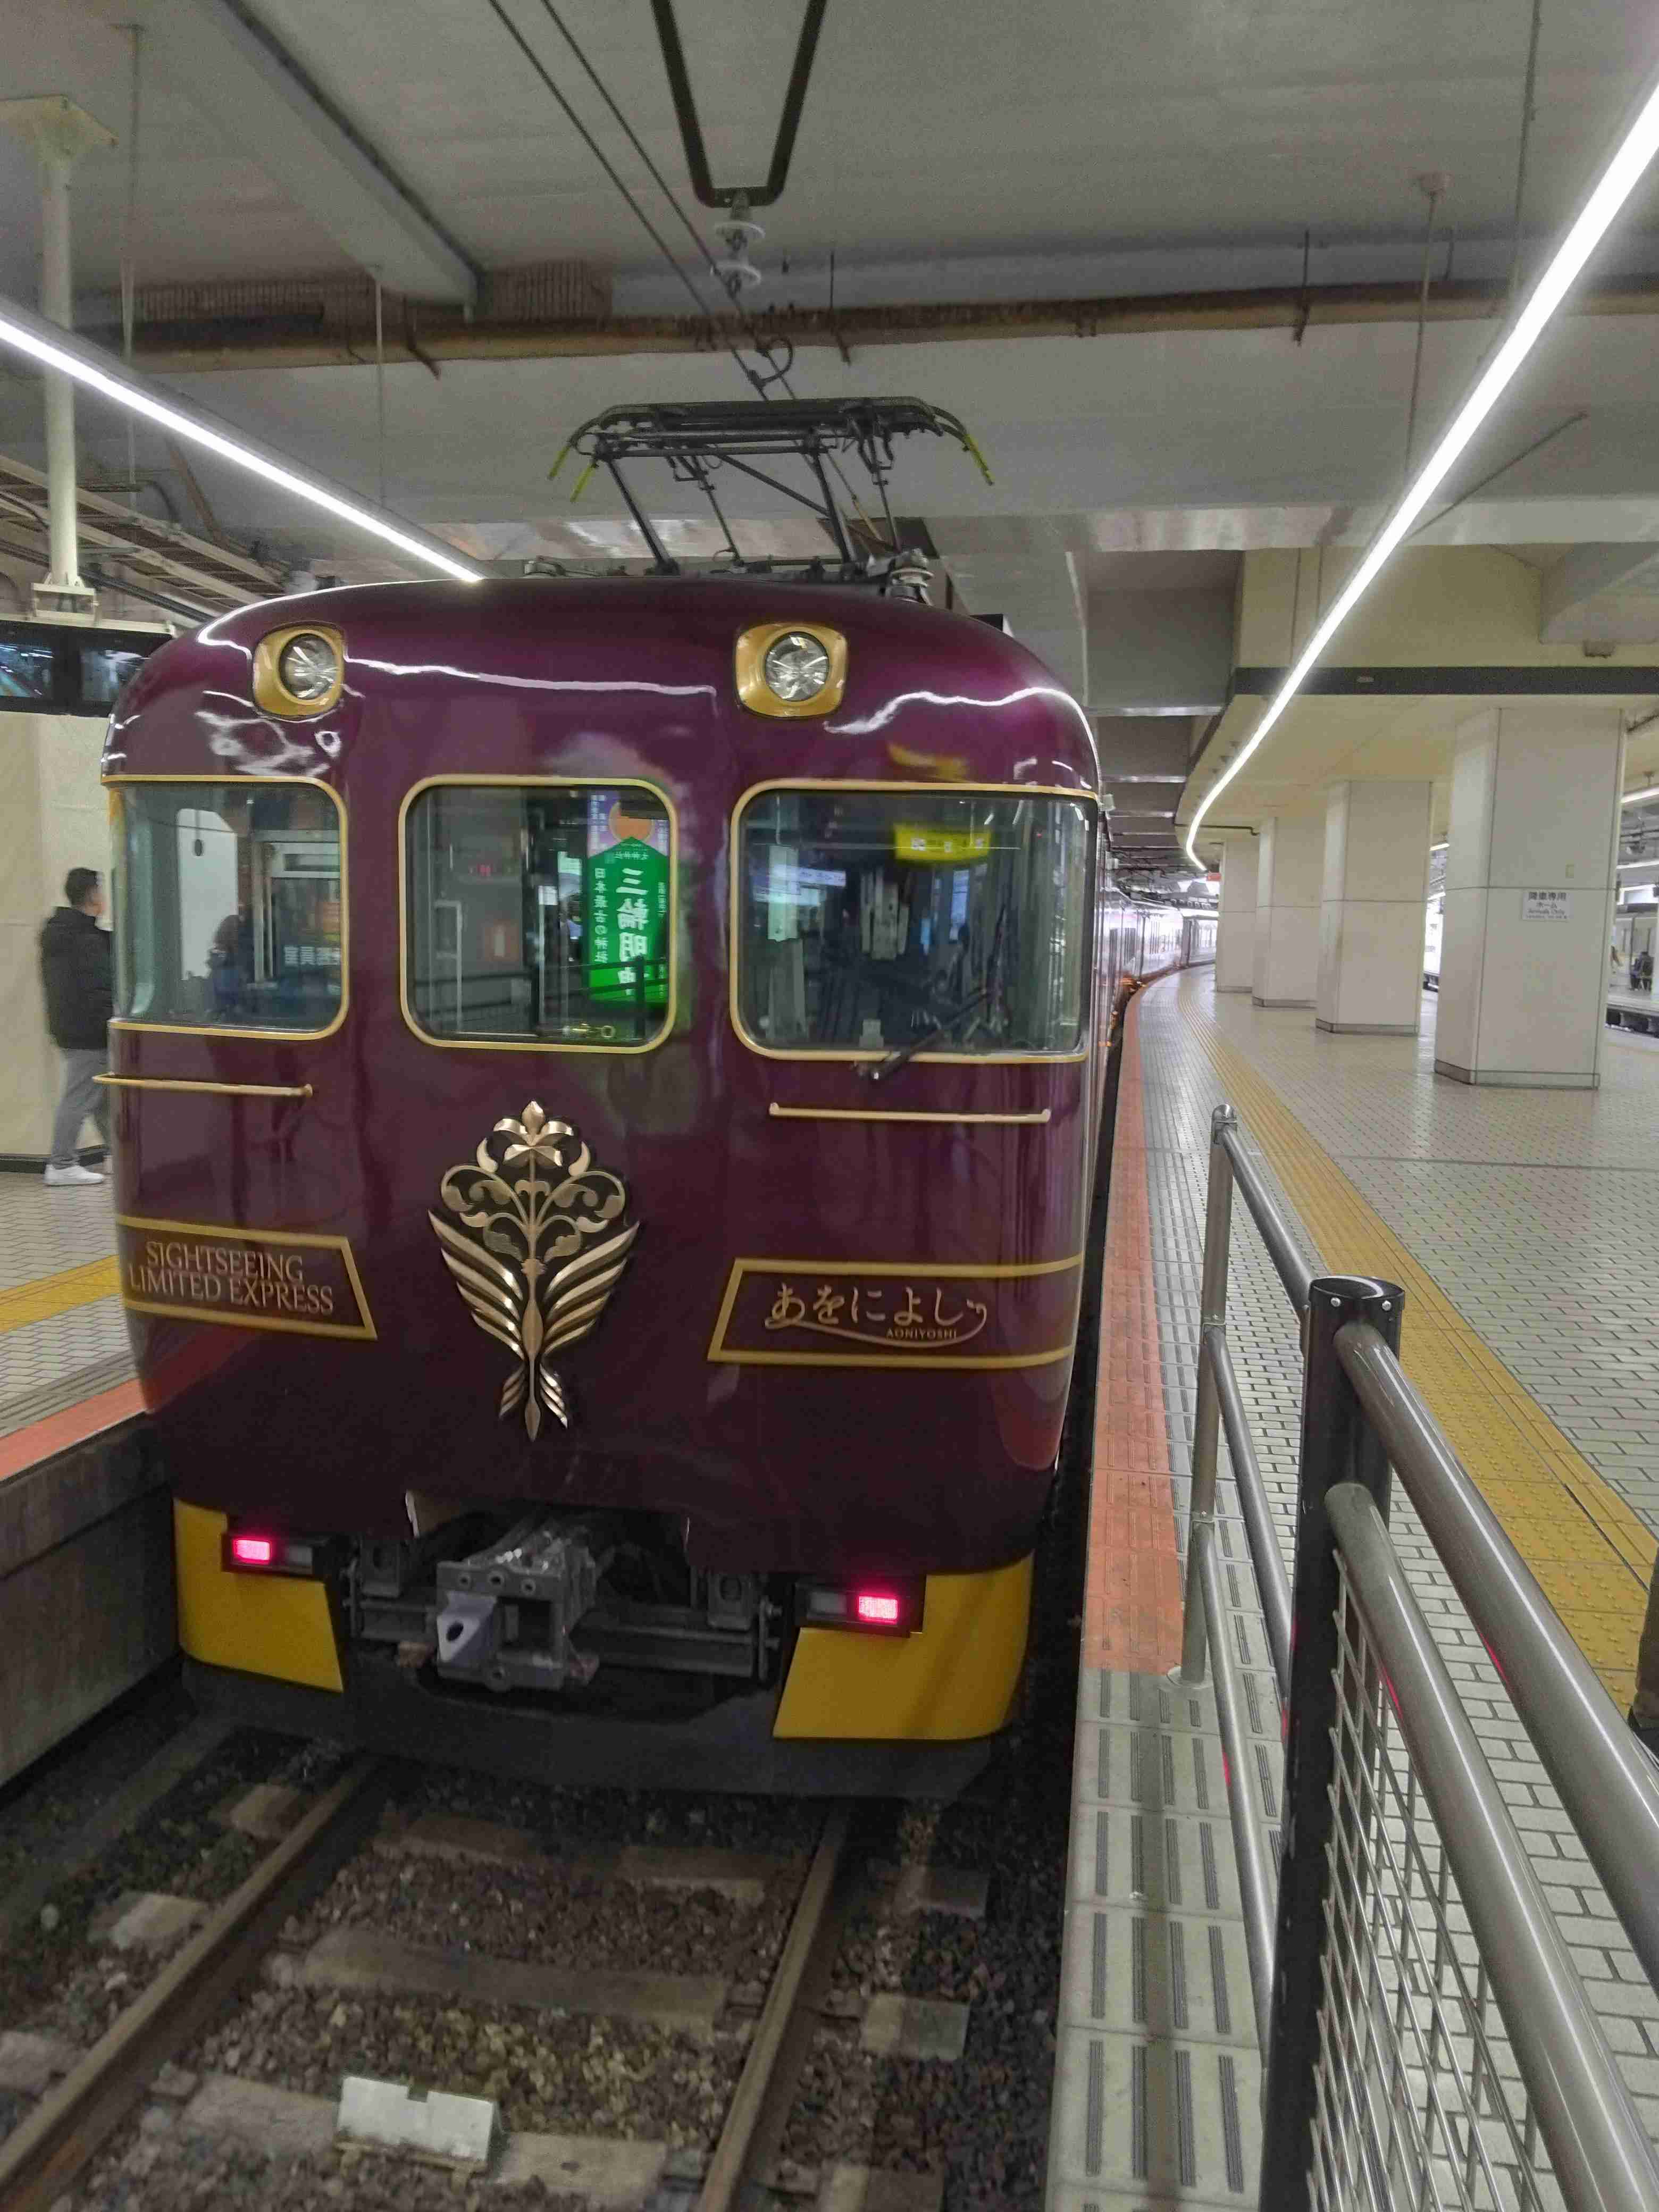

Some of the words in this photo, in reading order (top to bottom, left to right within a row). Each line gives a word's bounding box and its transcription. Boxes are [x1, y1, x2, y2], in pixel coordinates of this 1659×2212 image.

[145, 1241, 304, 1283] SIGHTSEEING
[128, 1263, 222, 1302] LIMITED
[229, 1278, 334, 1316] EXPRESS
[765, 1282, 964, 1329] あをによし
[885, 1327, 958, 1340] AONIYOSHI
